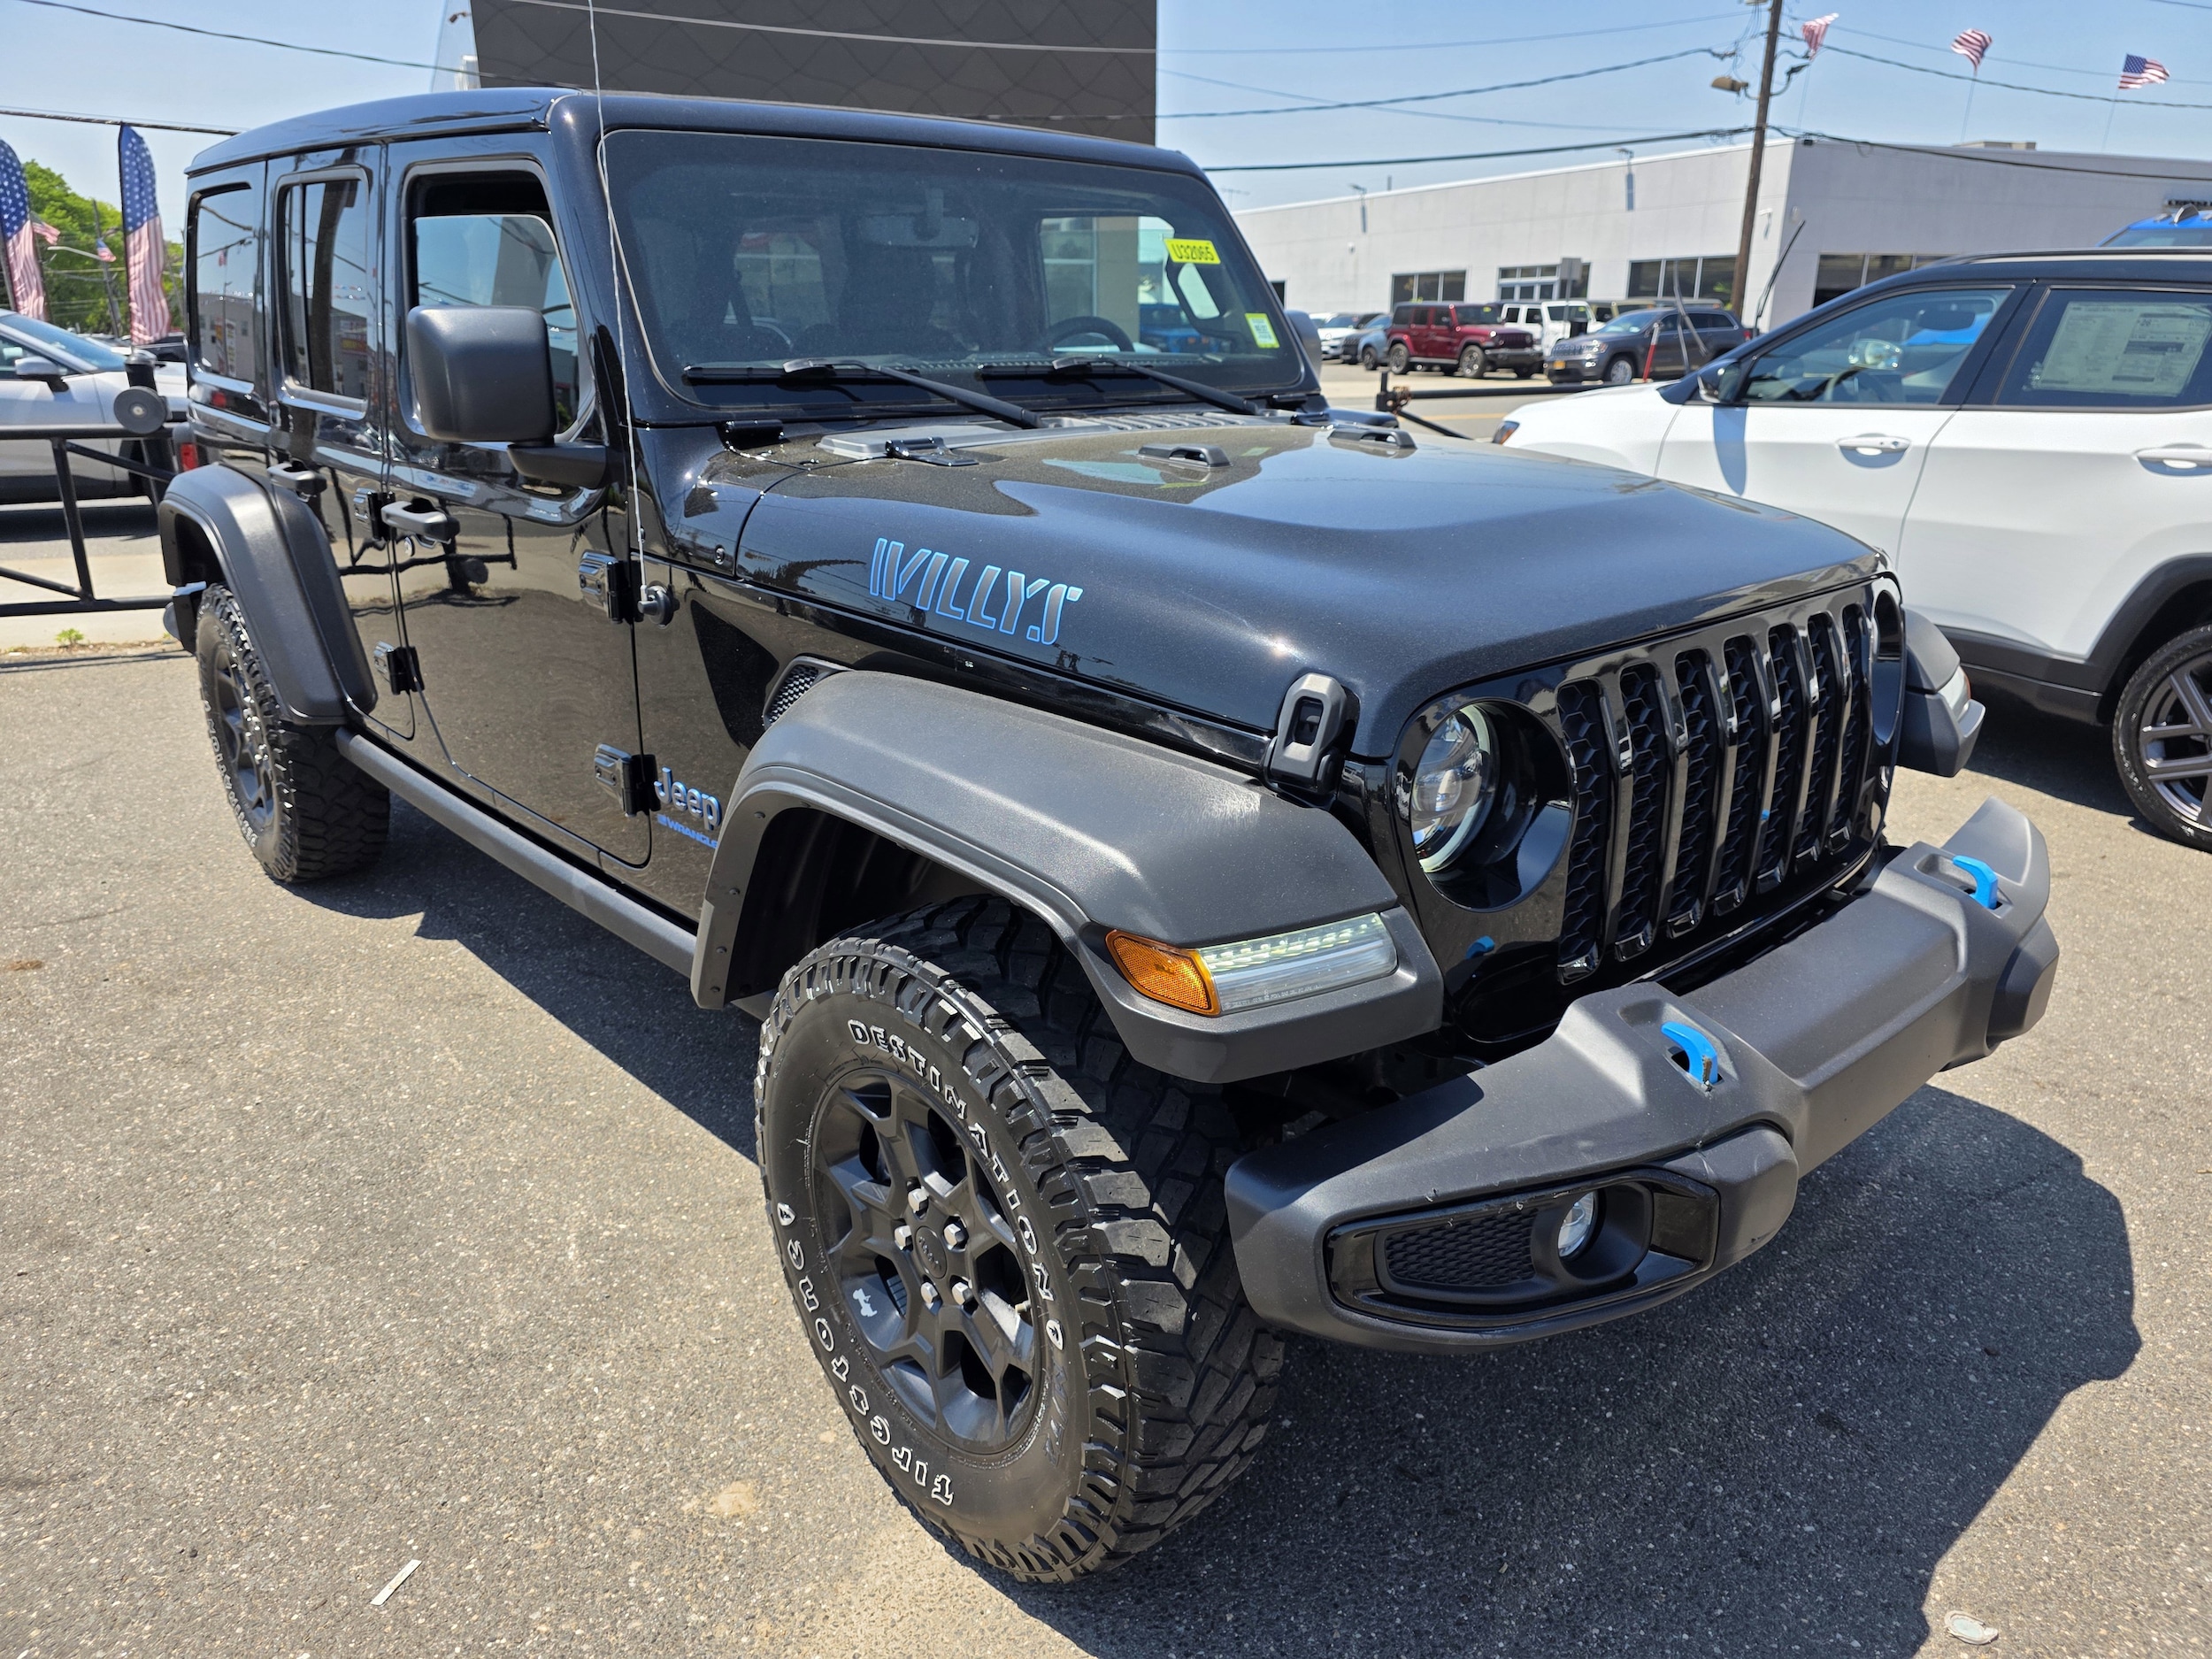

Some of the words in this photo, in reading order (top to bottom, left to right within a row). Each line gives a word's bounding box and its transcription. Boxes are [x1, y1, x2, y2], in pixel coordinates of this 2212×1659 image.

[870, 538, 1084, 645] WILLYS
[654, 766, 722, 831] Jeep
[847, 1018, 1055, 1302] DESTINATION
